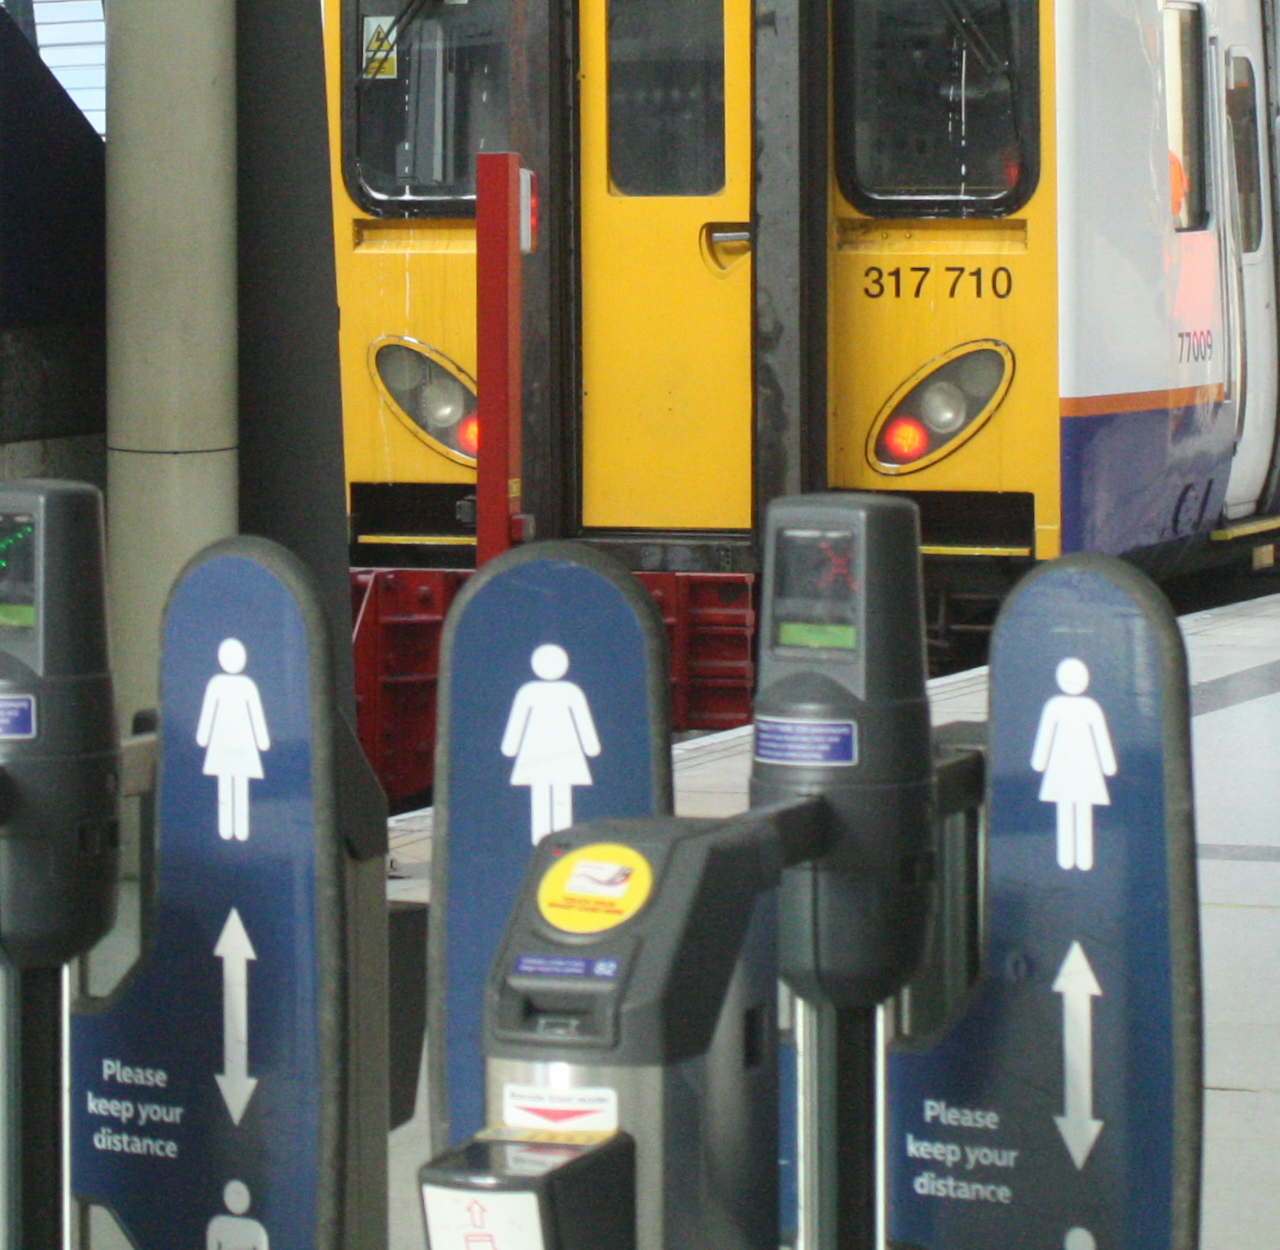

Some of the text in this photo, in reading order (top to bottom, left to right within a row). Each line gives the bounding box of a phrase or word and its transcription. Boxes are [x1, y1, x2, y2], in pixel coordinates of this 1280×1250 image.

[863, 266, 1012, 299] 317 710
[1177, 329, 1213, 363] 77009
[102, 1058, 168, 1088] Please
[87, 1090, 184, 1126] keep your
[923, 1099, 999, 1129] Please
[93, 1127, 178, 1158] distance
[906, 1133, 1018, 1169] keep your
[913, 1170, 1013, 1204] distance
